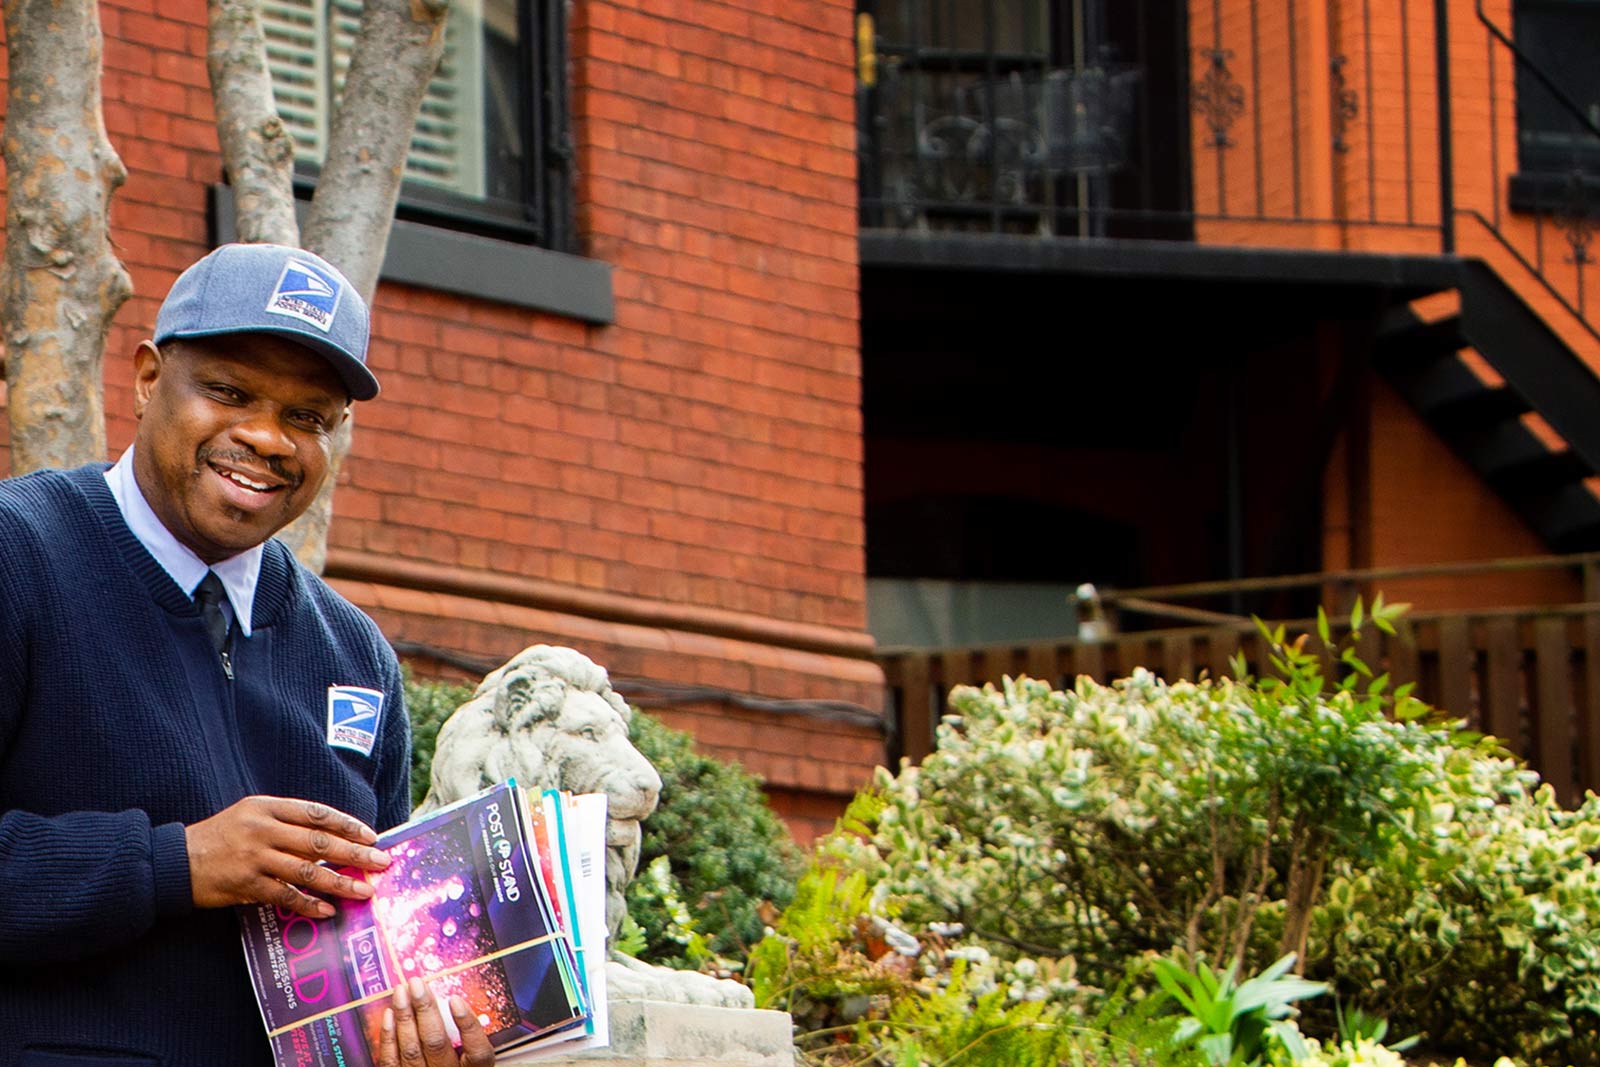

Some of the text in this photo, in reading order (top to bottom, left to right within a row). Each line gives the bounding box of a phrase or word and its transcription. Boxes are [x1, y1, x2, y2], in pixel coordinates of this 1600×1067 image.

[486, 802, 520, 902] POST UP STAND
[490, 863, 498, 877] OUR
[493, 877, 504, 903] MISSION
[265, 903, 297, 1009] FIRST IMPRESSIONS
[357, 935, 385, 996] IGNITE
[331, 1037, 338, 1045] A
[303, 1051, 313, 1063] AT
